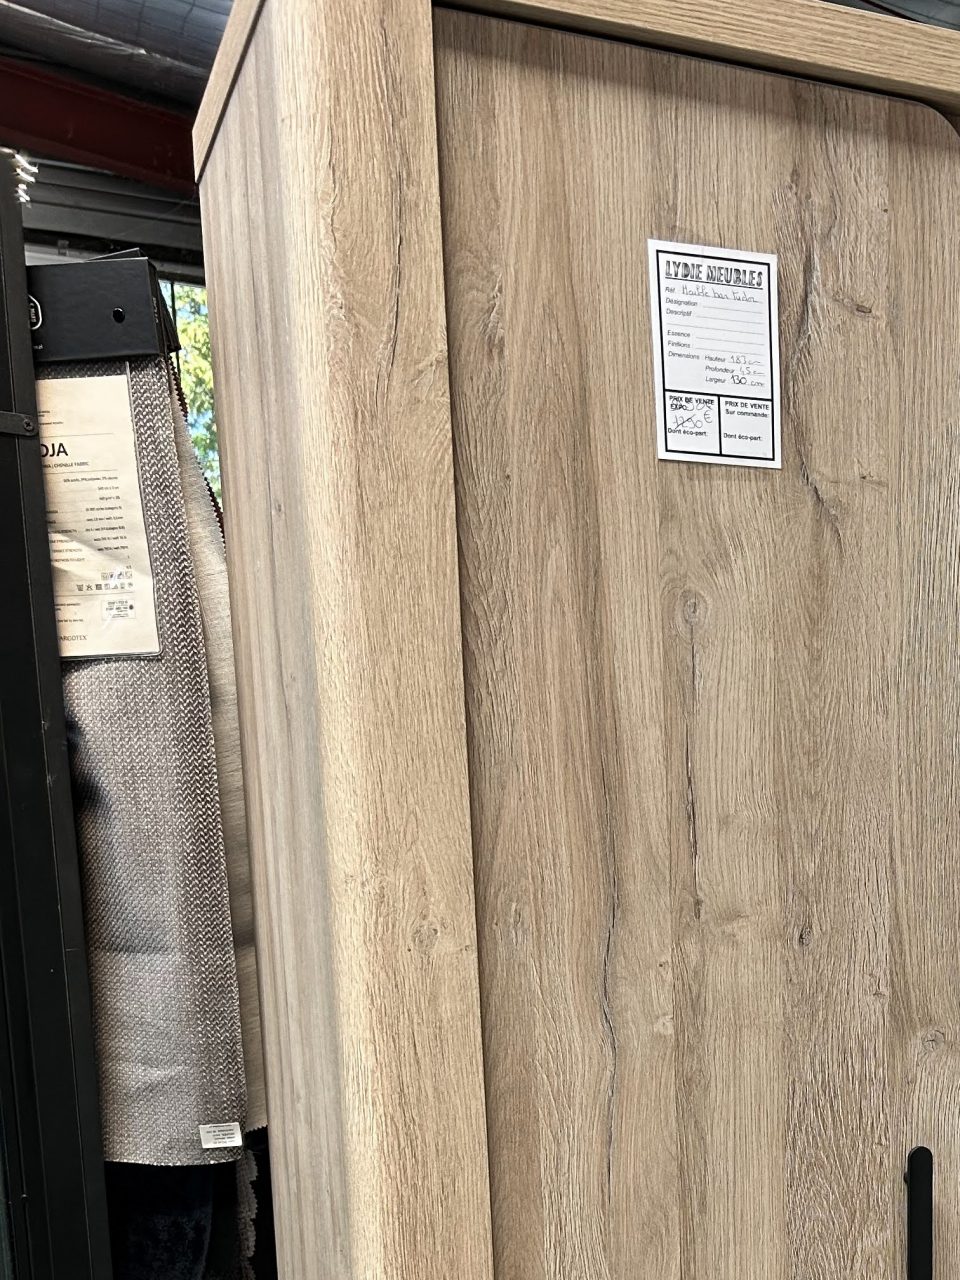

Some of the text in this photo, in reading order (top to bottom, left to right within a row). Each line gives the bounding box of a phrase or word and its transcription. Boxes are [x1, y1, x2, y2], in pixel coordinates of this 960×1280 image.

[665, 260, 763, 287] LYDIE MEUBLES
[667, 330, 691, 338] Essence
[704, 355, 726, 363] Hauteur
[705, 365, 735, 374] Profondeur
[705, 376, 726, 384] Largeur
[731, 375, 747, 385] 130
